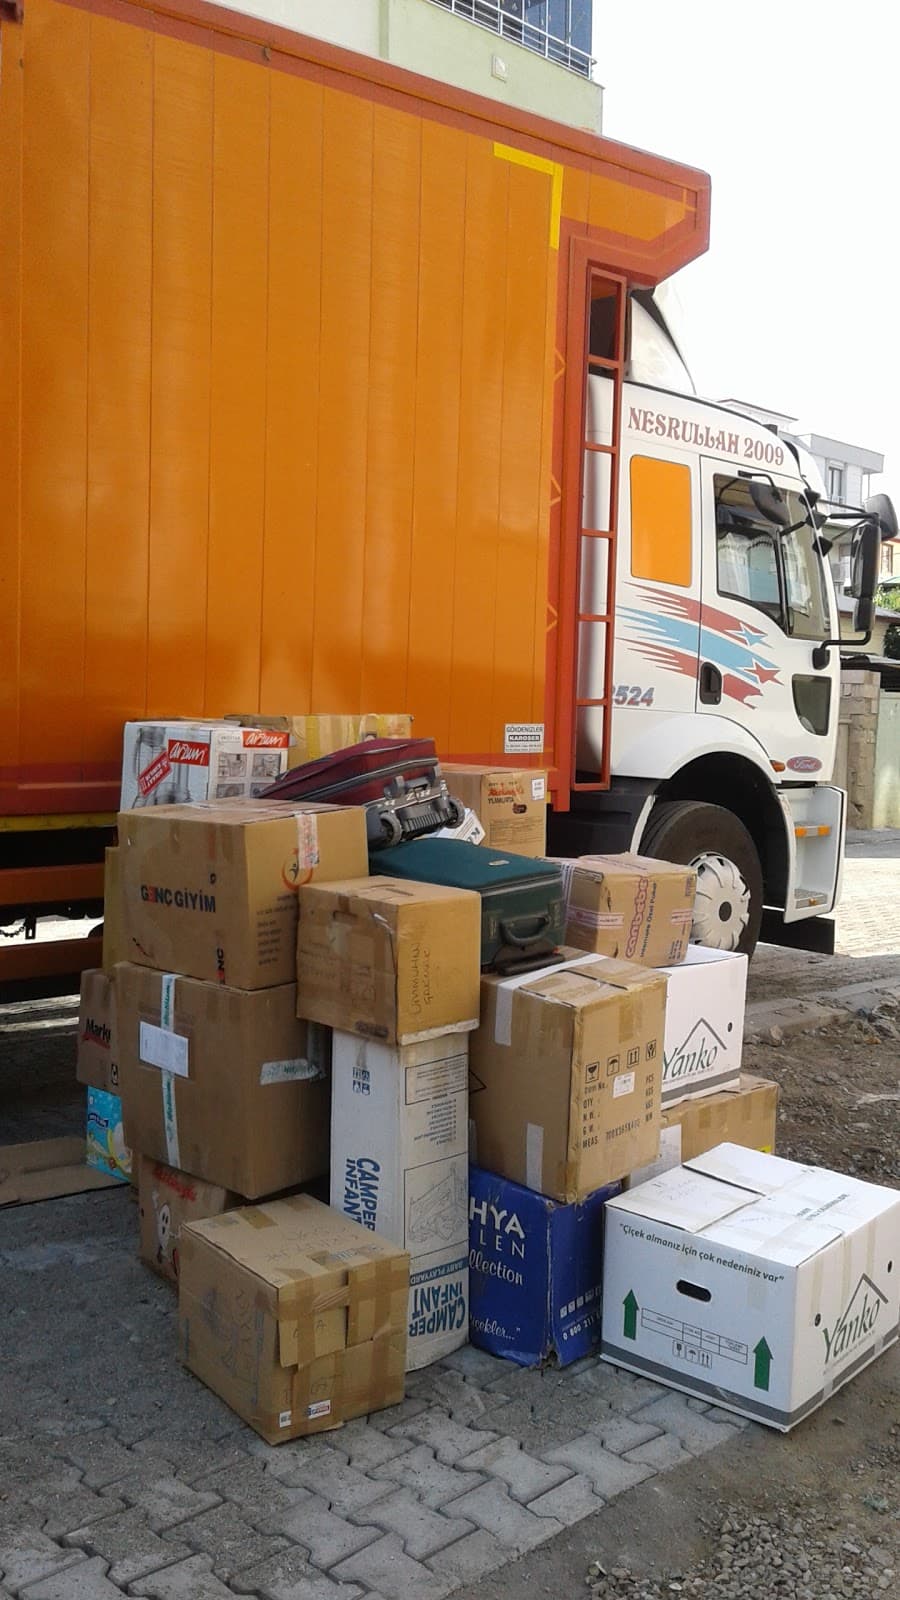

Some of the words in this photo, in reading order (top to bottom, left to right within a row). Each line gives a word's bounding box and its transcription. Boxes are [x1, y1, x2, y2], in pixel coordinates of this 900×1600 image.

[628, 407, 739, 455] NESRULLAH
[744, 437, 784, 466] 2009
[612, 685, 655, 707] 524
[662, 1037, 717, 1081] Yanko
[699, 1251, 715, 1263] çok
[716, 1256, 762, 1278] nedeniniz
[409, 1295, 466, 1337] CAMPER
[412, 1281, 463, 1318] INFANT
[822, 1293, 880, 1365] Yanko
